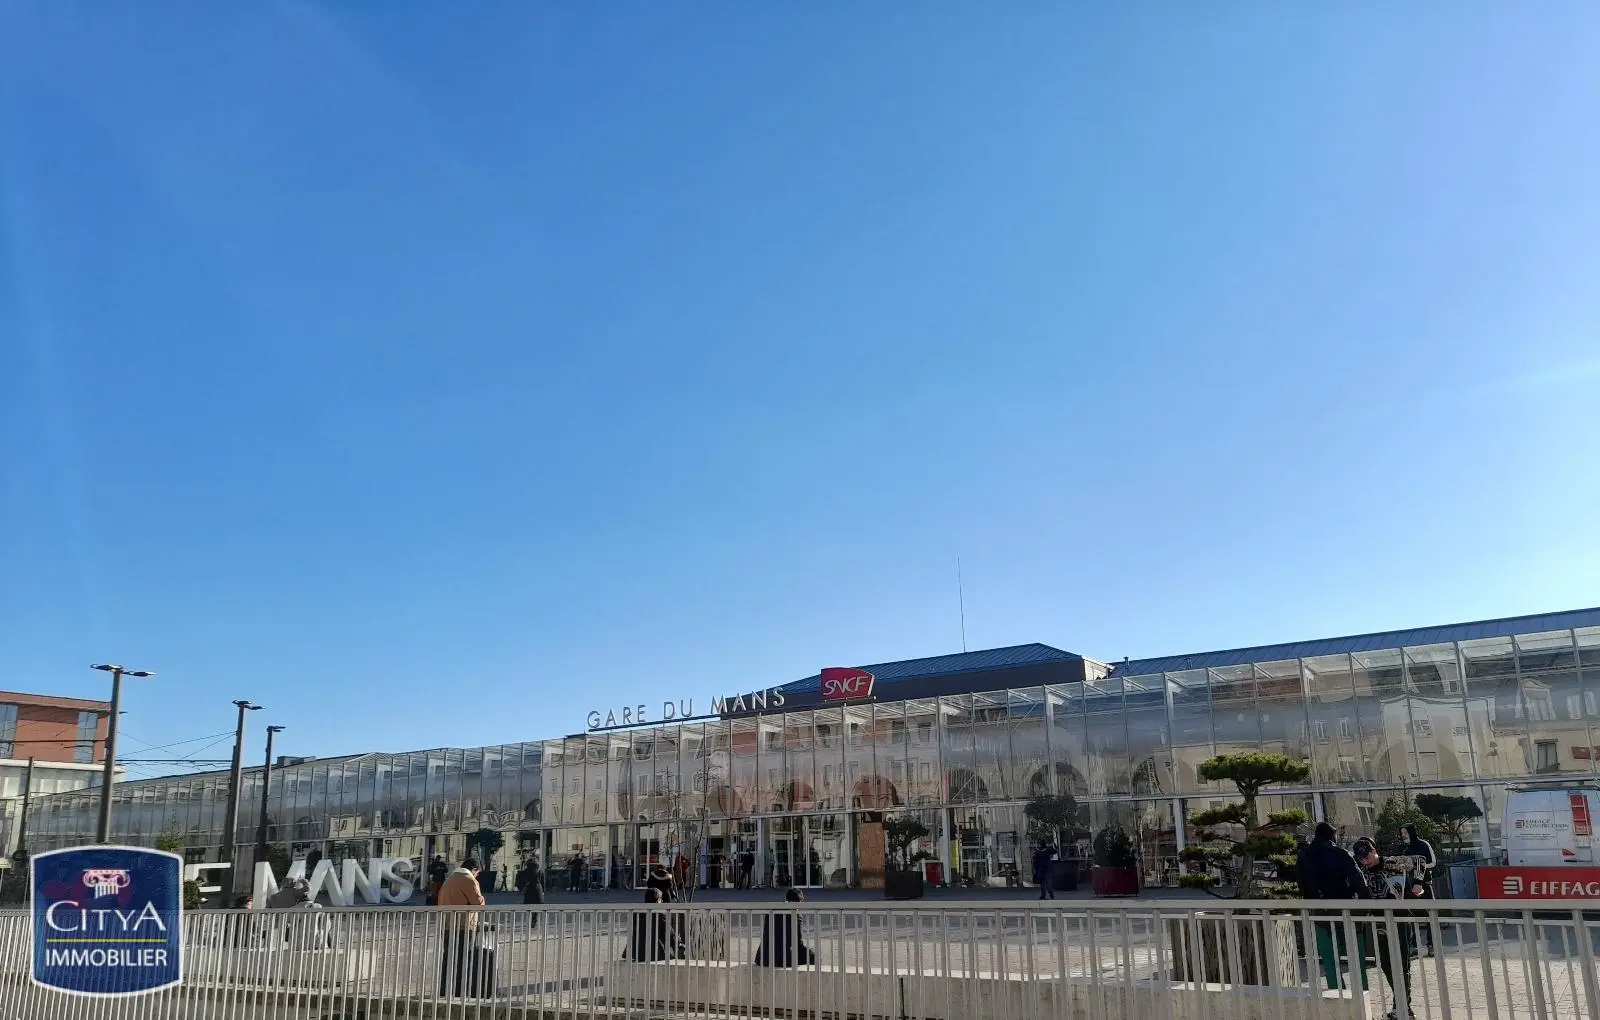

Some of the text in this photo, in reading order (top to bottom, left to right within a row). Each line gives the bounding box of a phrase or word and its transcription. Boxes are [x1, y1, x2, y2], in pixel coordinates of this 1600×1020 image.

[823, 676, 869, 695] SNCF
[587, 687, 784, 728] GARE DU MANS
[253, 858, 414, 908] MANS
